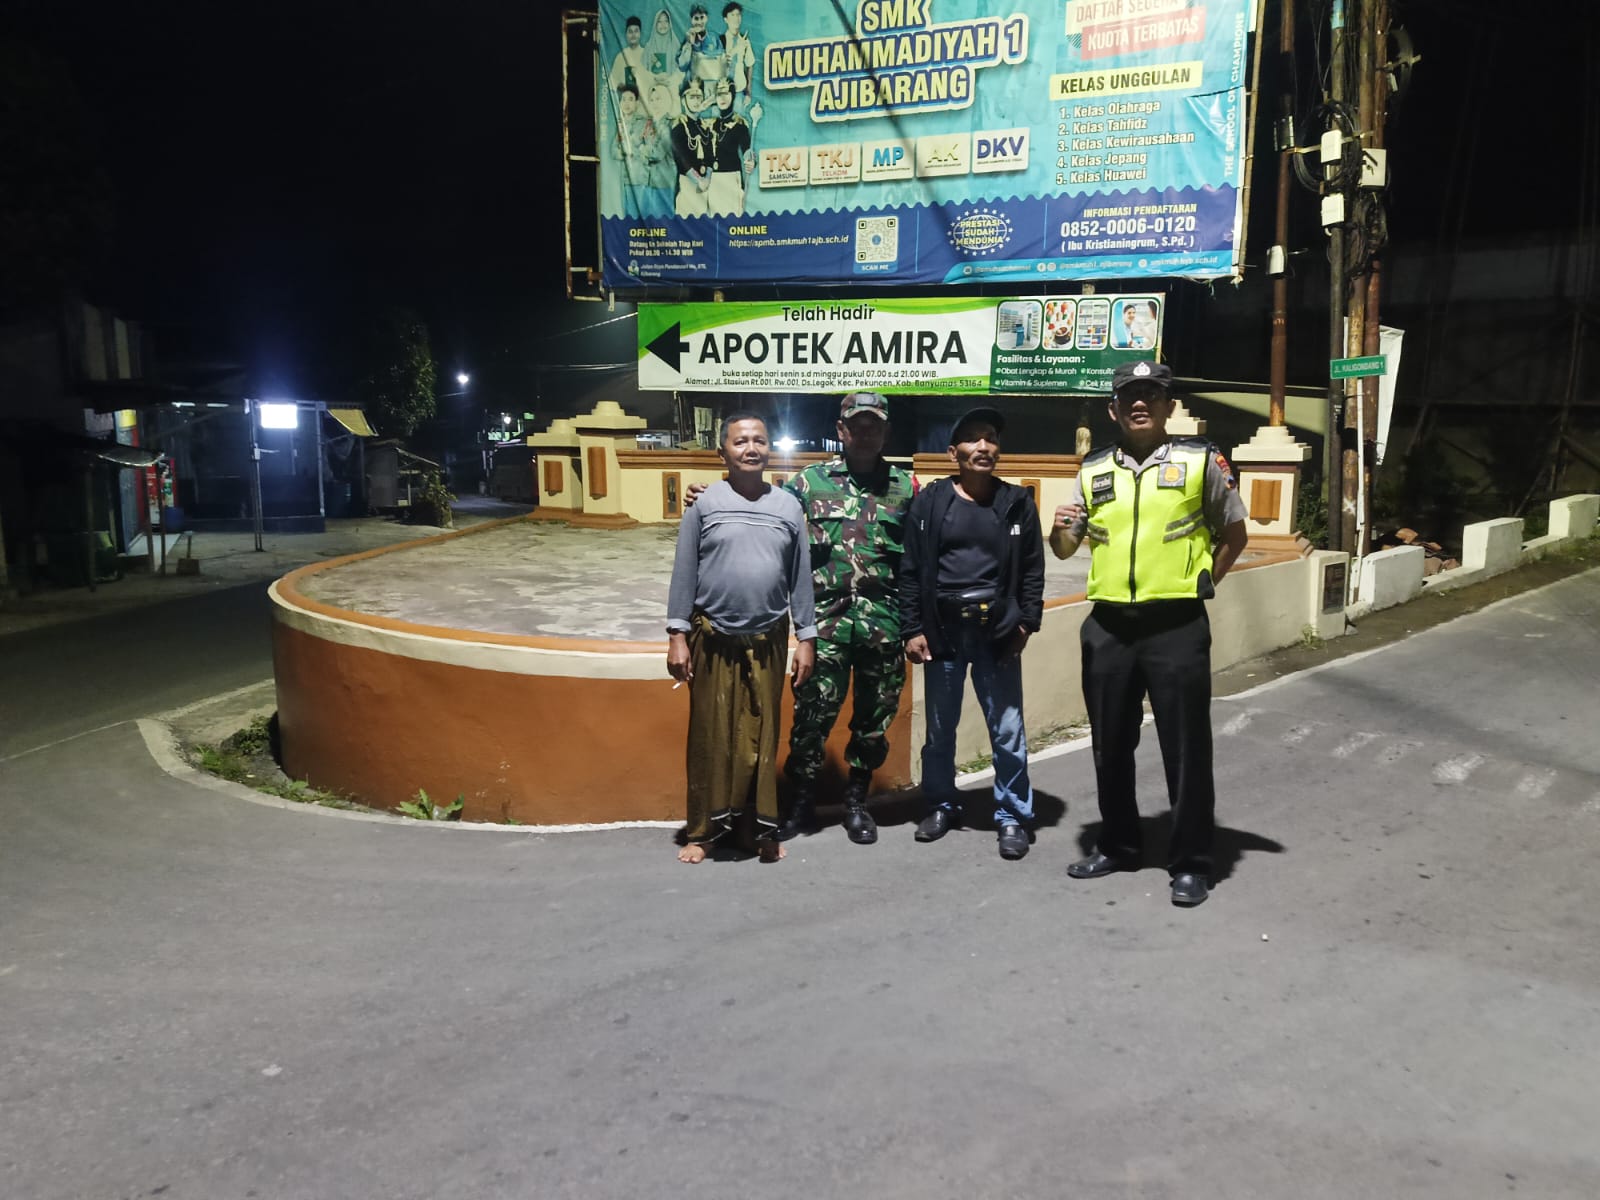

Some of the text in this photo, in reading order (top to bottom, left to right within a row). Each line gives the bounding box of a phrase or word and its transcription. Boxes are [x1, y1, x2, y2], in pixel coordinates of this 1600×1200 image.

[863, 0, 923, 32] SMK
[1076, 0, 1124, 23] DAFTAR
[1087, 15, 1200, 51] KUOTA TERBATAS
[771, 18, 1022, 80] MUHAMMADIYAH 1
[817, 68, 967, 112] AJIBARANG
[1060, 68, 1192, 95] KELAS UNGGULAN
[1224, 154, 1234, 178] THE
[1231, 11, 1245, 83] CHAMPIONS
[1059, 100, 1161, 119] 1. Kelas Olahraga
[1058, 118, 1148, 136] 2. Kelas Tahfidz
[976, 135, 1025, 159] DKV
[1057, 131, 1195, 152] 3. Kelas Kewirausahaan
[766, 152, 801, 172] TKJ
[816, 148, 853, 169] TKJ
[872, 146, 905, 167] MP
[1056, 152, 1147, 168] 4. Kelas Jepang
[1056, 168, 1147, 185] 5. Kelas Huawei
[1083, 203, 1197, 218] INFORMASI PENDAFTARAN
[729, 225, 768, 235] ONLINE
[960, 219, 1000, 228] PRESTASI
[965, 228, 996, 236] SUDAH
[1060, 216, 1196, 237] 0852-0006-0120
[955, 236, 1004, 246] MENDUNIA
[1068, 240, 1083, 250] Ibu
[782, 304, 876, 321] Telah Hadir
[698, 331, 968, 364] APOTEK AMIRA
[996, 354, 1033, 363] Fasilitas
[1034, 355, 1041, 363] &
[1042, 354, 1081, 365] Layanan
[722, 369, 740, 377] buka
[741, 369, 764, 379] setiap
[812, 370, 841, 380] minggu
[842, 370, 865, 379] pukul
[866, 370, 887, 378] 07.00
[900, 370, 920, 378] 21.00
[1019, 368, 1047, 376] Lengkap
[1054, 367, 1077, 375] Murah
[914, 379, 957, 389] Banyumas
[1033, 379, 1068, 387] Suplemen
